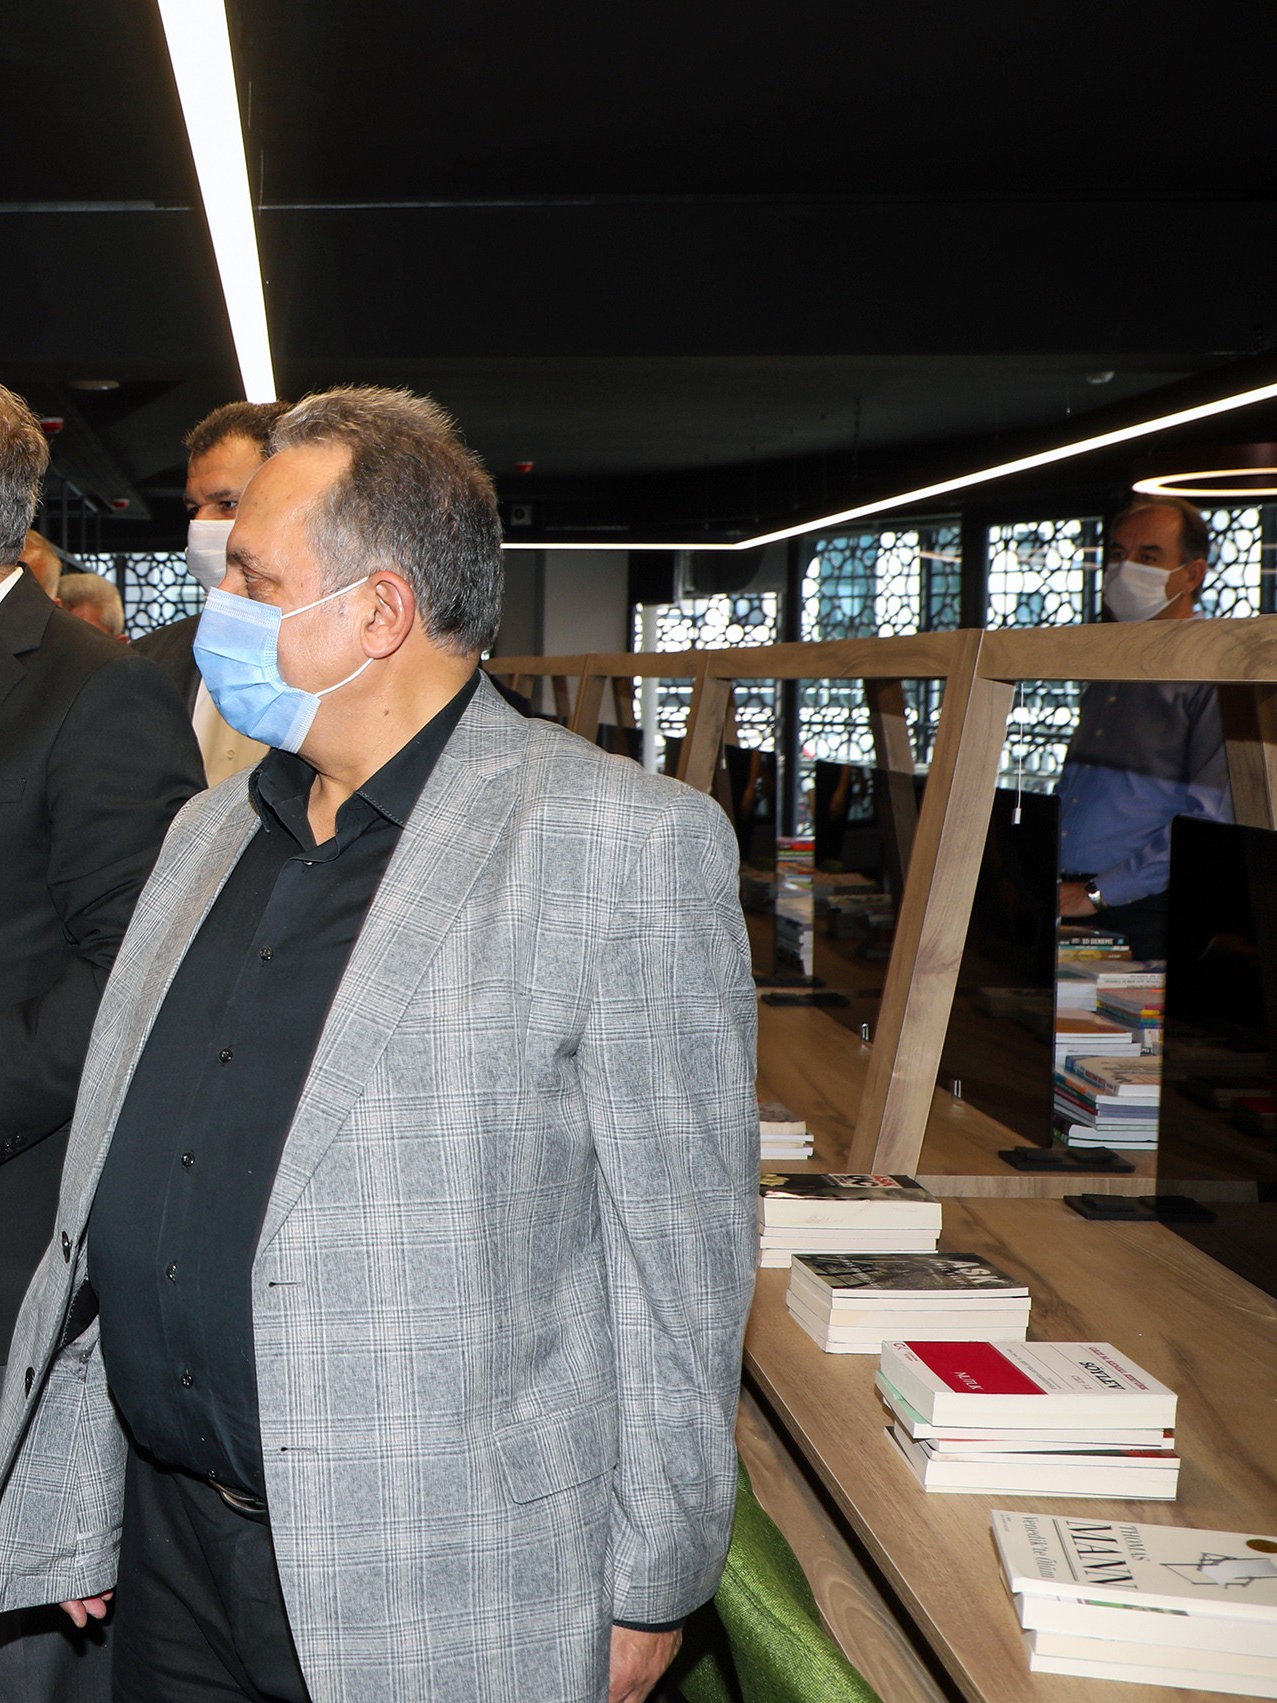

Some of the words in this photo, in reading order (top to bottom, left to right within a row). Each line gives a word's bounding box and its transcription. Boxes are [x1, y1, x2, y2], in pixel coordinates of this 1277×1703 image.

[1079, 1361, 1126, 1390] SÖYLEV
[1021, 1516, 1048, 1559] Venedik'te
[1038, 1558, 1058, 1579] Ölüm
[1065, 1520, 1139, 1590] MANN
[1118, 1525, 1150, 1562] THOMAS
